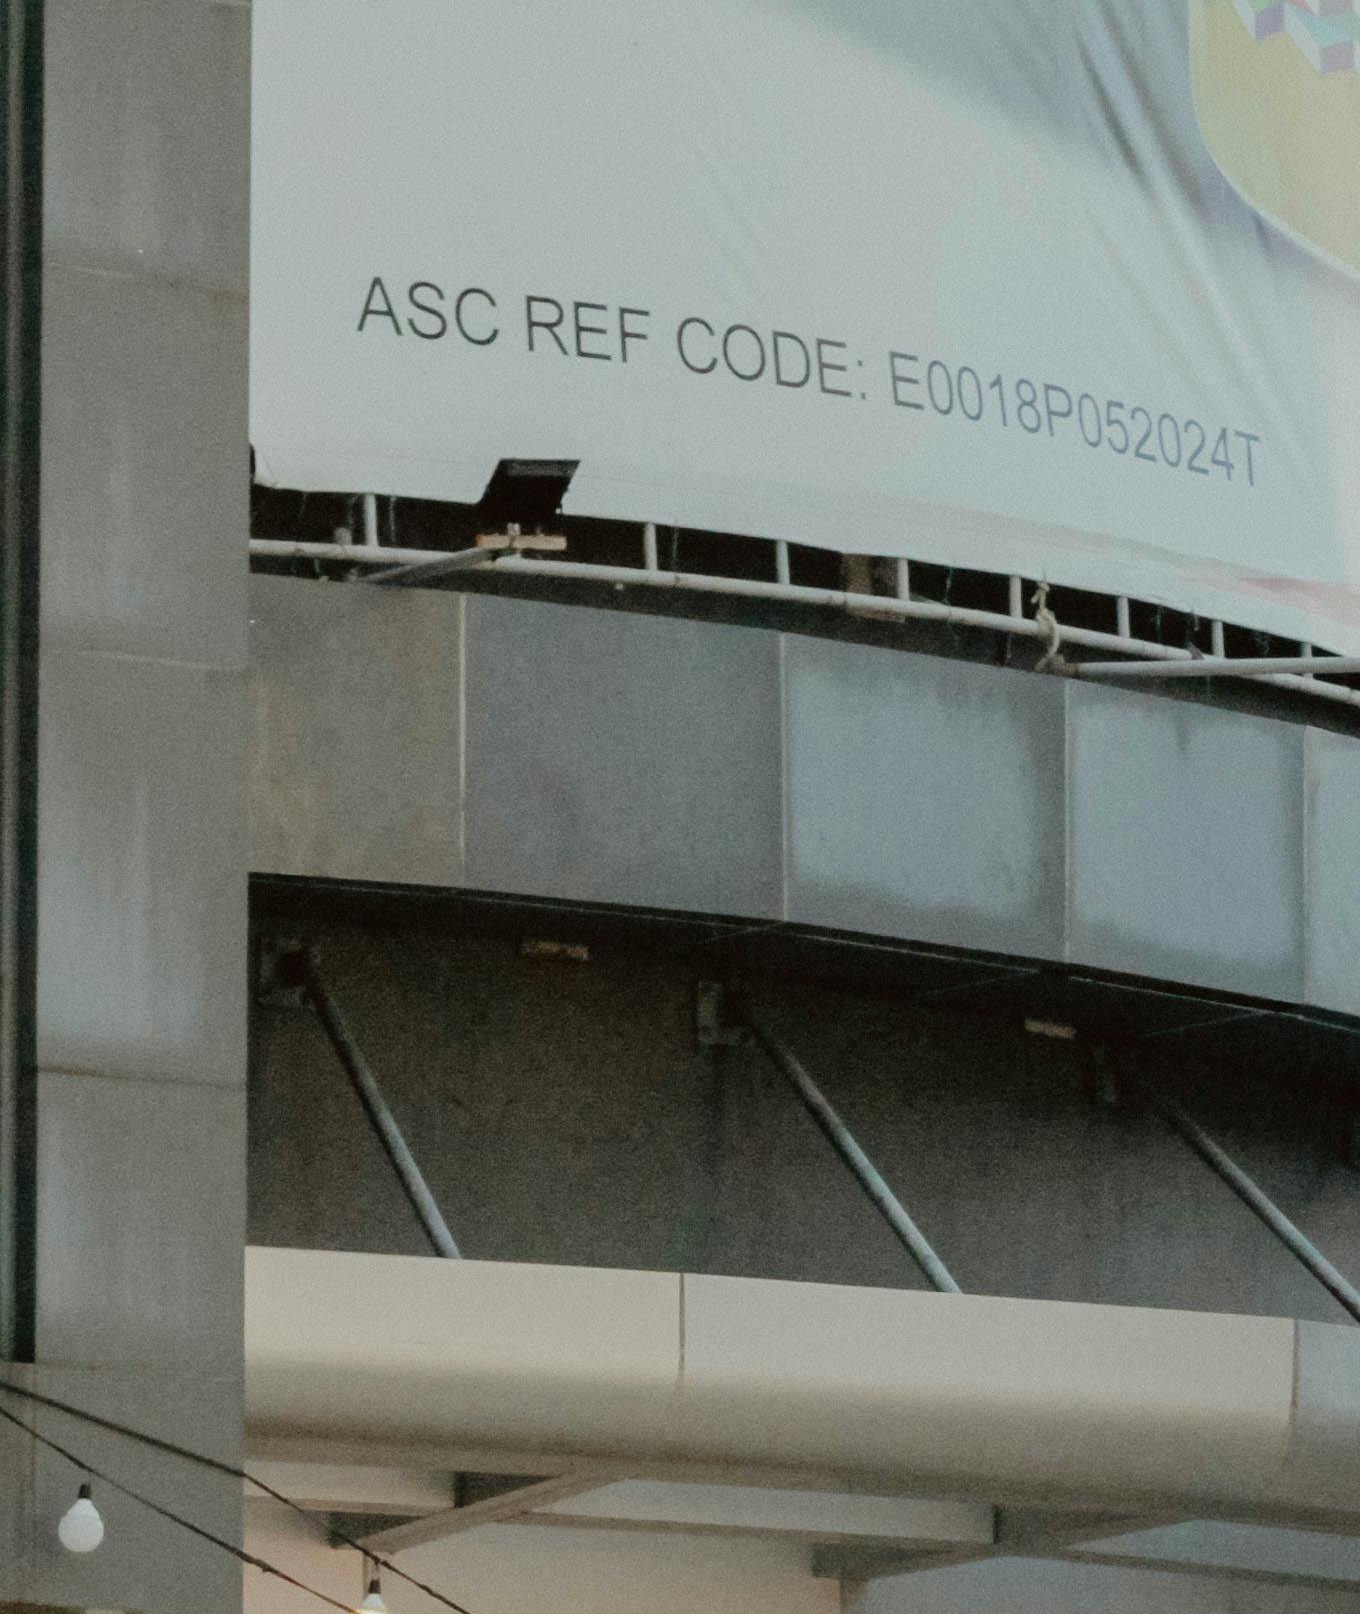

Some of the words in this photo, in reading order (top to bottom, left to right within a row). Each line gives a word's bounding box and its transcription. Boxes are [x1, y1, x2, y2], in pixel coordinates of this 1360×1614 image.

[358, 276, 500, 346] ASC
[526, 295, 650, 363] REF
[677, 317, 867, 401] CODE:
[889, 352, 1260, 487] E0018P052024T
